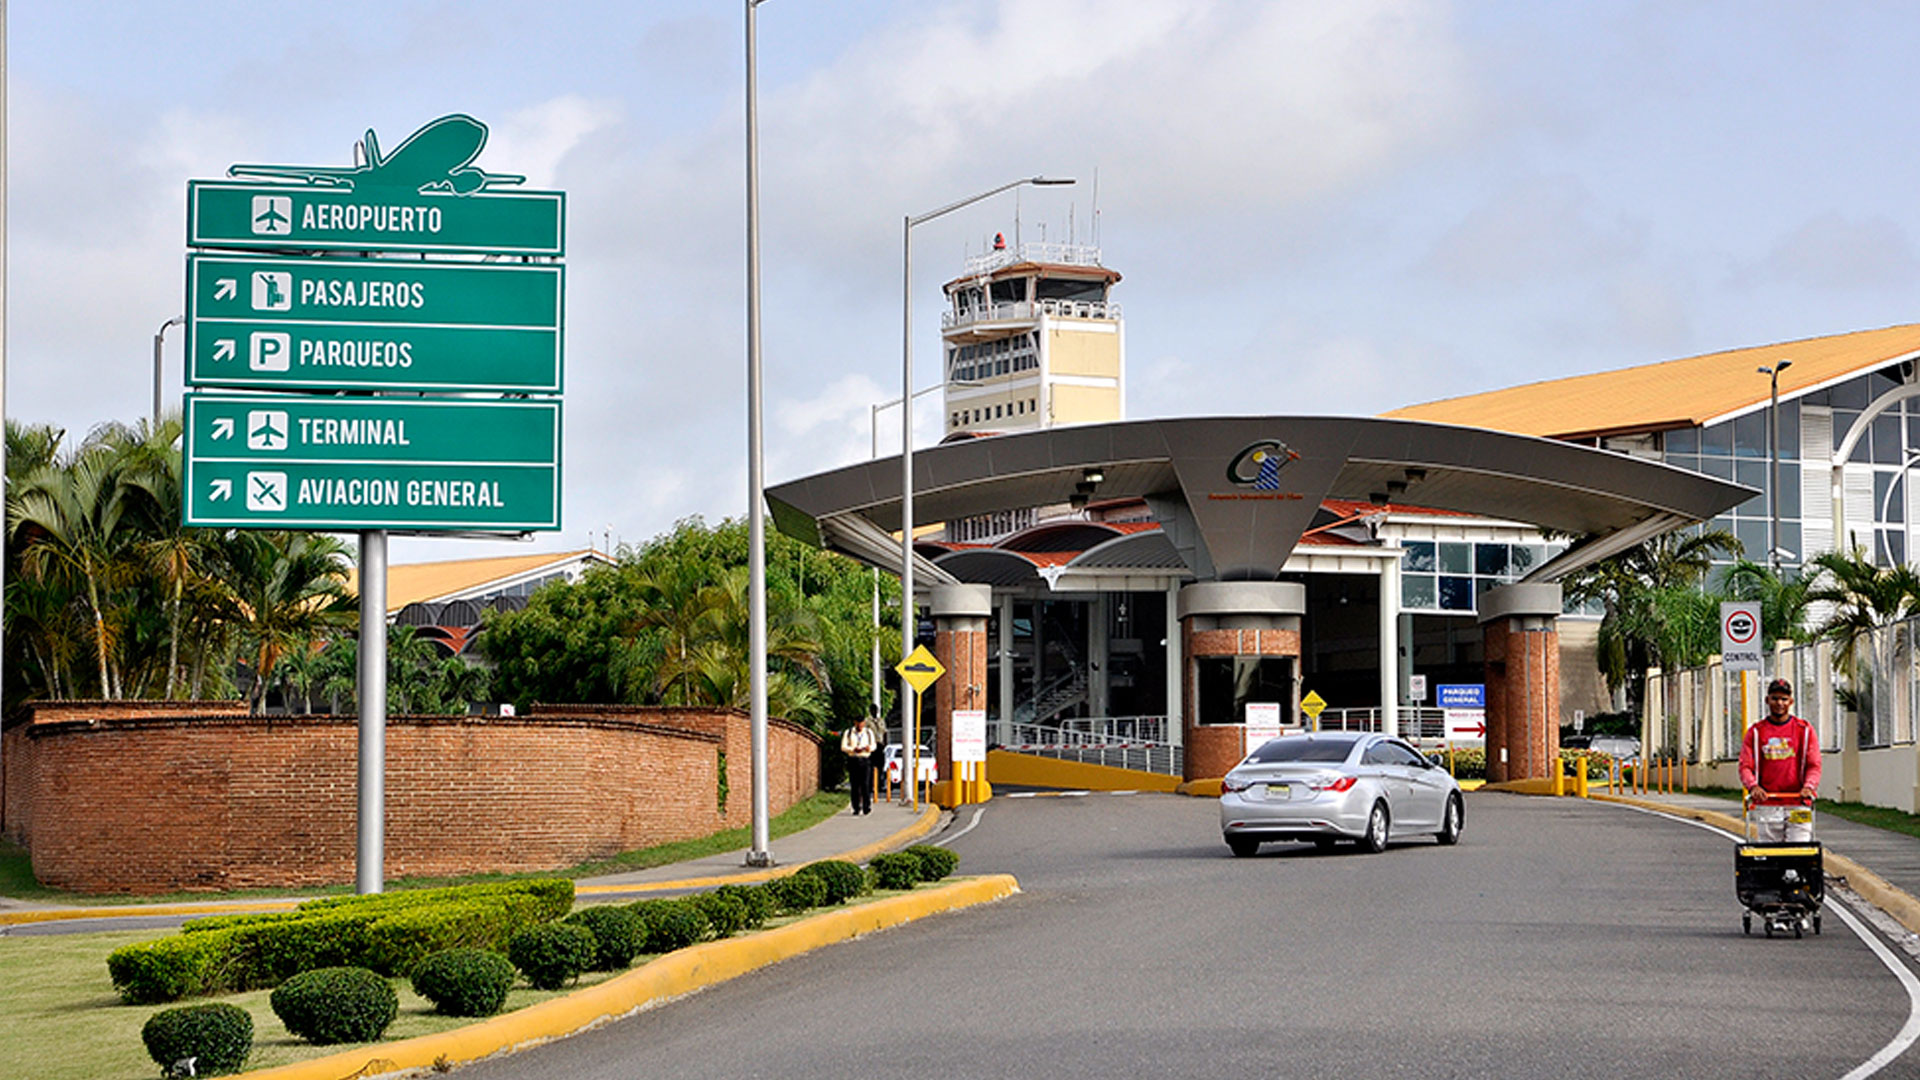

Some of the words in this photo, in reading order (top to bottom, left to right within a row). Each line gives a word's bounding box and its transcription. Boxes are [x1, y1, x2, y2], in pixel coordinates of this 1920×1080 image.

[302, 204, 442, 233] AEROPUERTO
[301, 280, 424, 309] PASAJEROS
[259, 339, 281, 365] P
[299, 340, 413, 368] PARQUEOS
[298, 418, 410, 446] TERMINAL
[297, 479, 399, 506] AVIACION
[406, 481, 505, 508] GENERAL
[1724, 652, 1759, 662] CONTROL
[1443, 688, 1480, 696] PARQUEO
[1443, 696, 1479, 704] GENERAL
